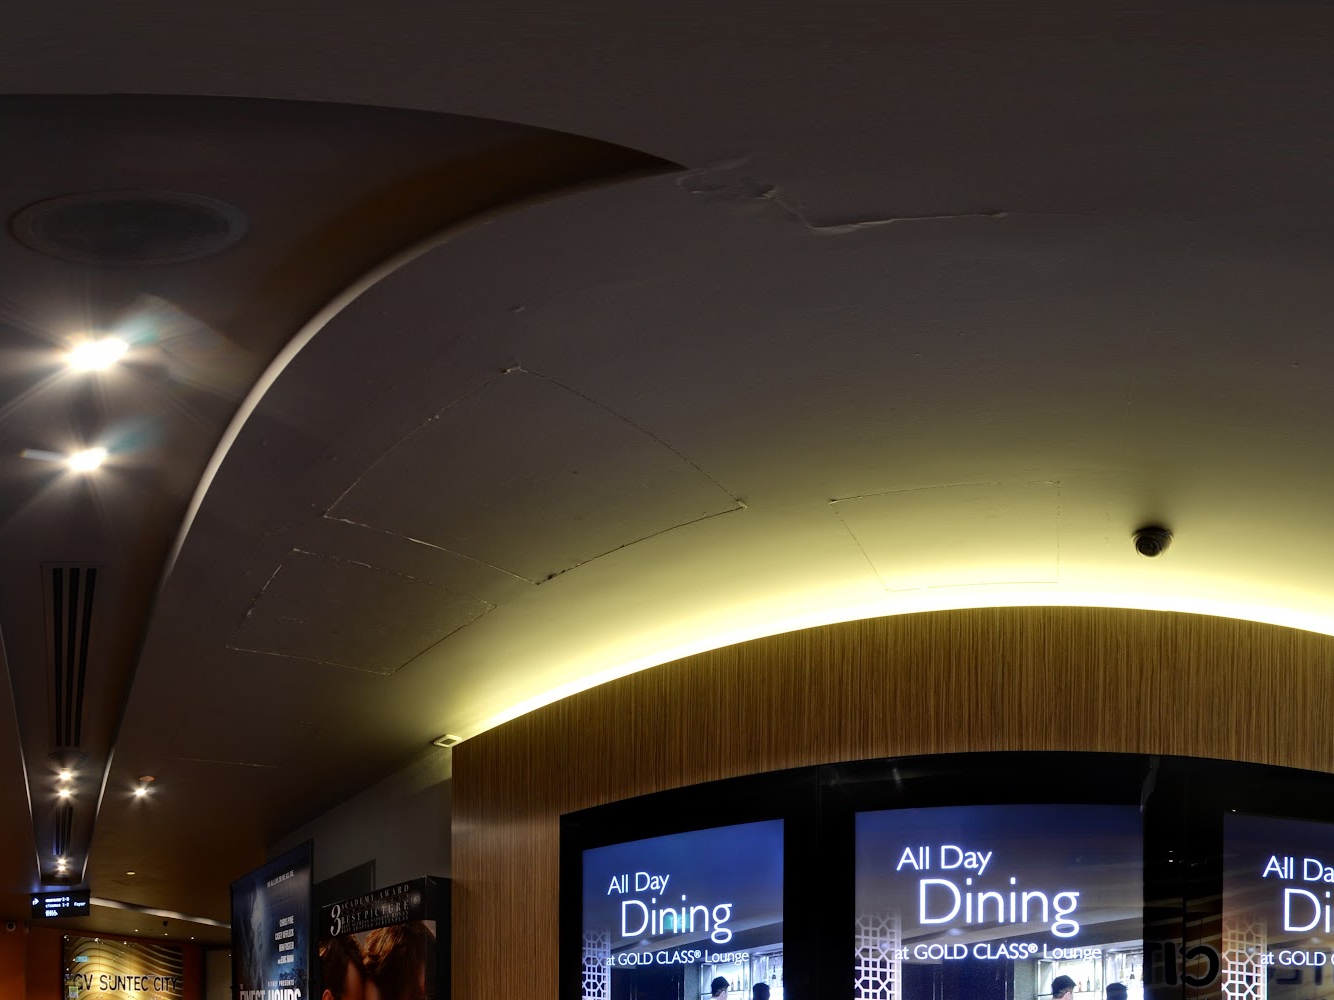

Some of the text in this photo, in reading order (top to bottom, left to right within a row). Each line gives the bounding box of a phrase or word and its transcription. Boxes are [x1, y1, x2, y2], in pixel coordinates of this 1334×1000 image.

[896, 845, 992, 876] All Day
[1262, 855, 1294, 879] All
[607, 871, 670, 895] All Day
[341, 893, 374, 910] ACADEMY
[379, 884, 409, 899] AWARD
[919, 876, 1080, 938] Dining
[364, 900, 409, 920] PICTURE
[621, 894, 733, 944] Dining
[606, 955, 616, 966] at
[618, 951, 653, 965] GOLD
[704, 949, 750, 966] Lounge
[894, 946, 909, 960] at
[913, 943, 968, 960] GOLD
[1043, 943, 1102, 962] Lounge
[1260, 952, 1275, 966] at
[1279, 950, 1326, 966] GOLD
[73, 973, 179, 992] GV SUNTEC CITY
